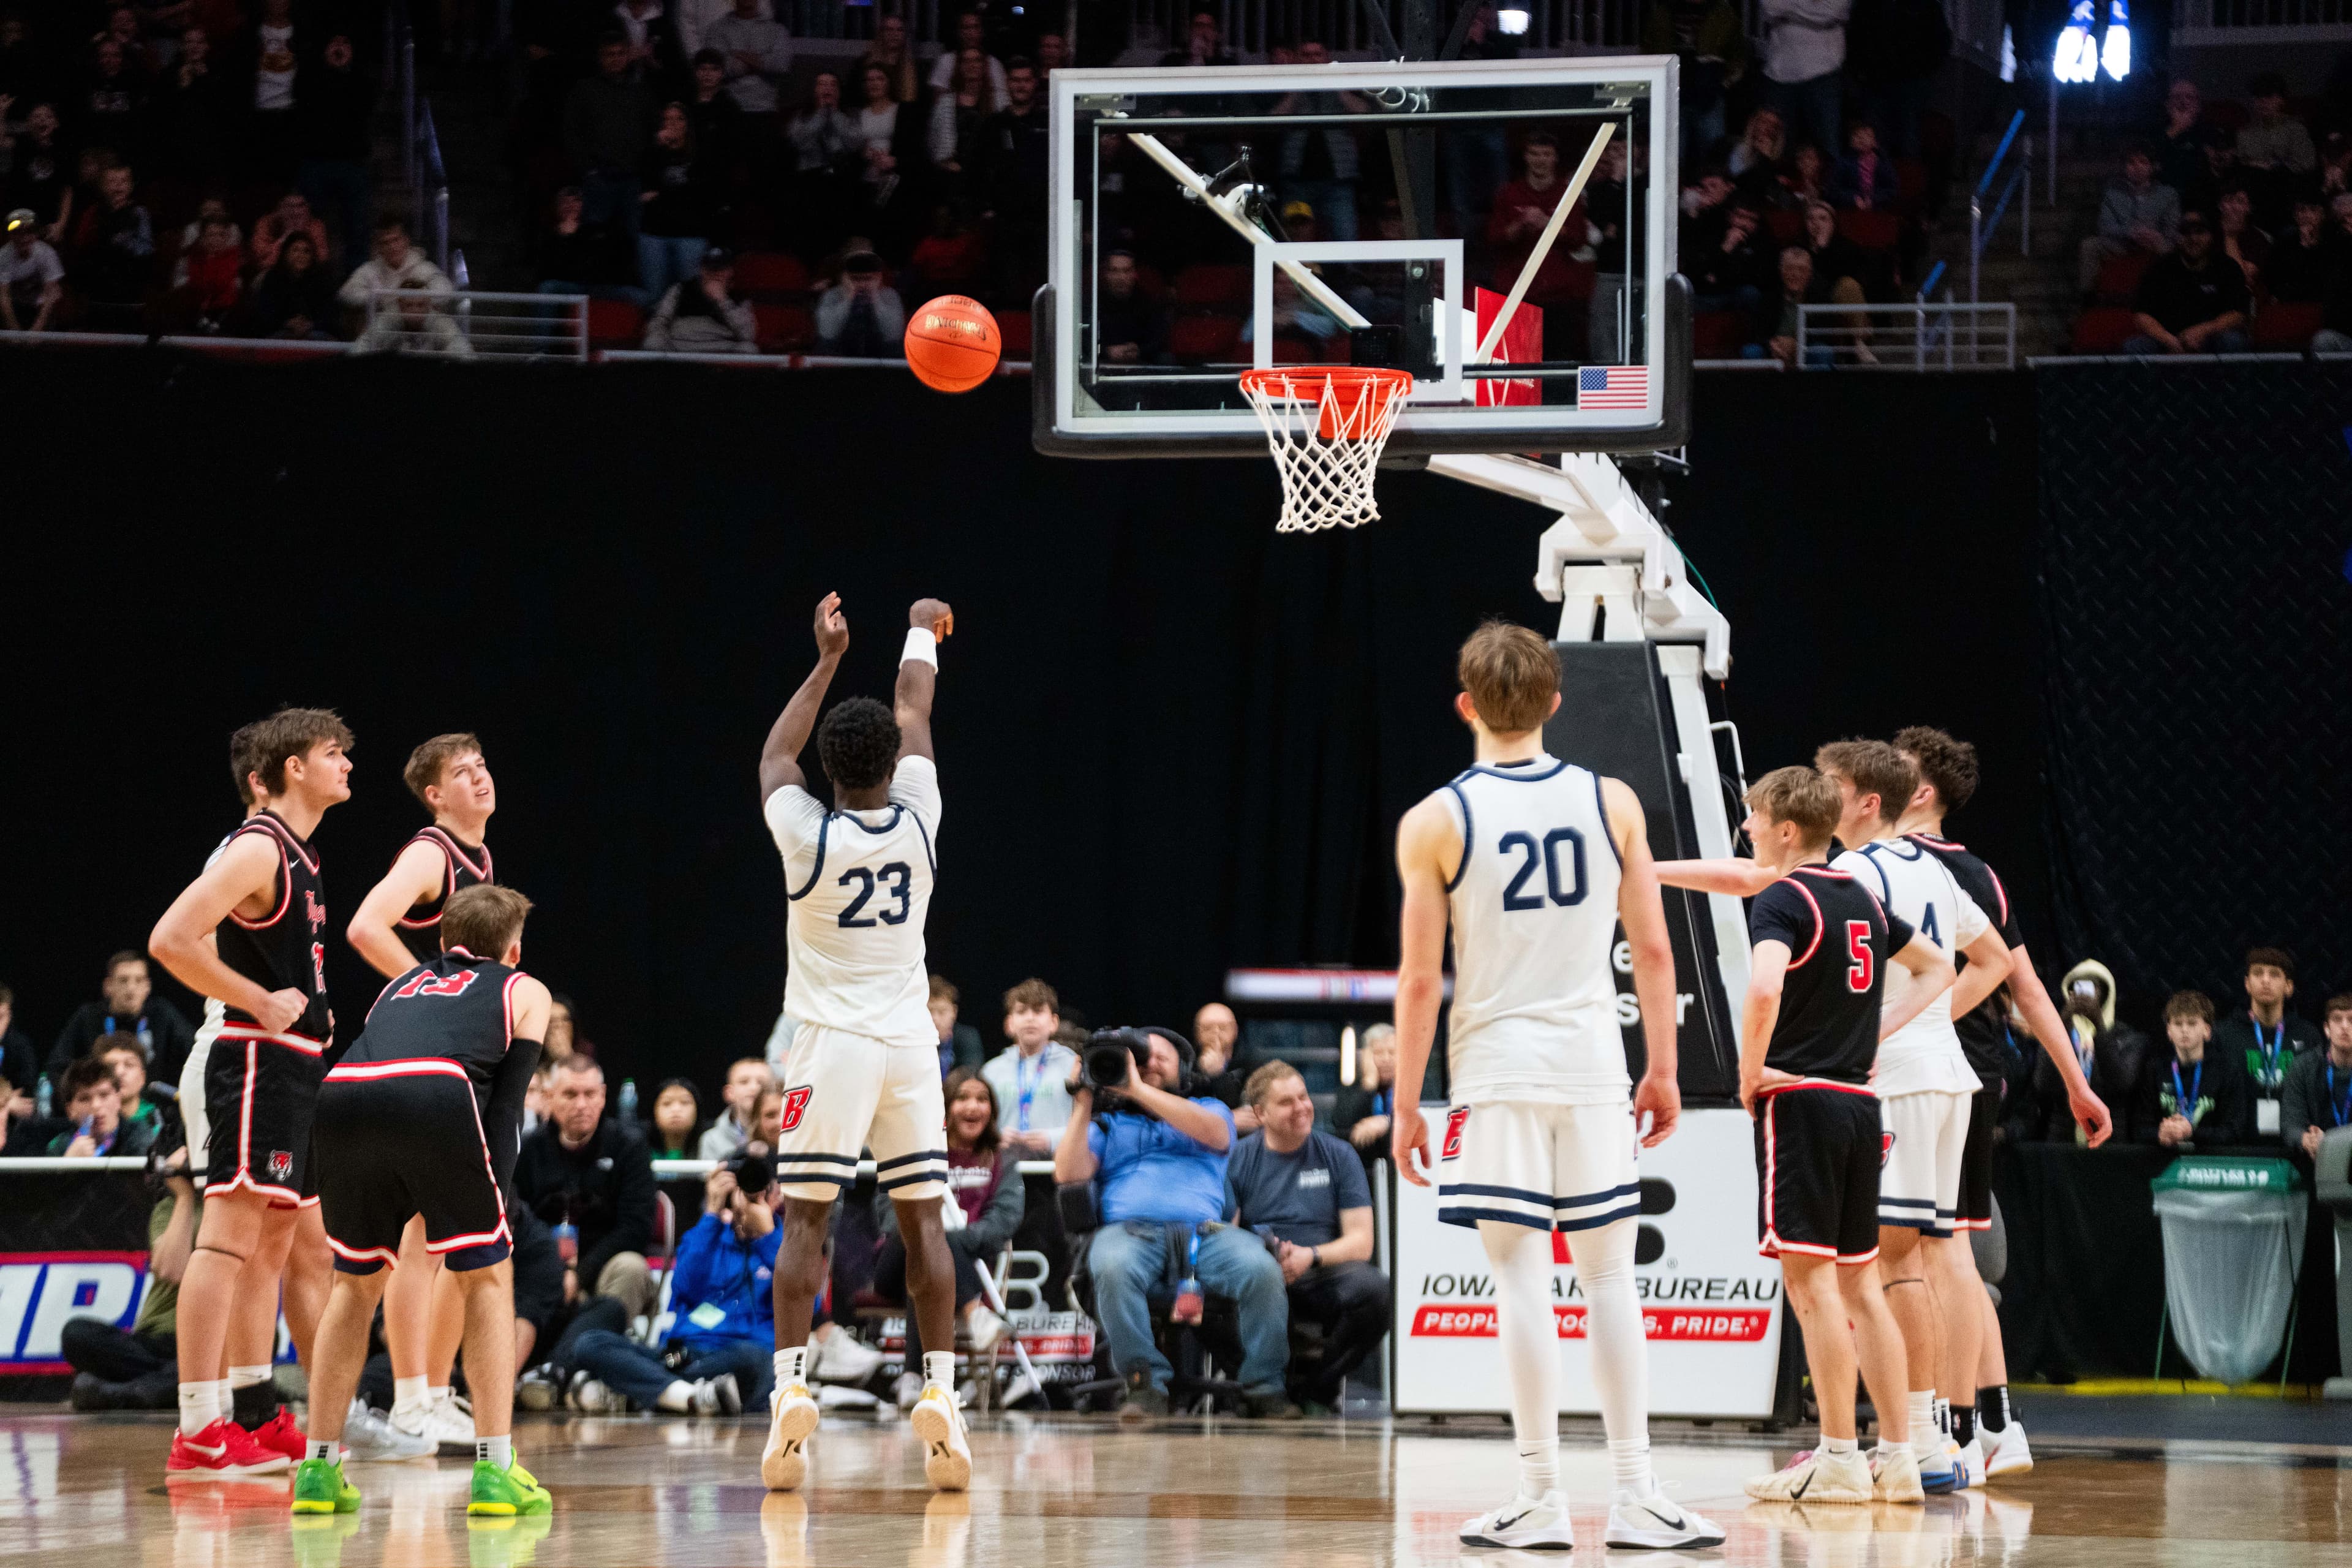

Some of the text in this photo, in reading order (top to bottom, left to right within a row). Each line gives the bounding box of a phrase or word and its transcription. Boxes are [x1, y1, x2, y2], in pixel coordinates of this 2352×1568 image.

[1499, 826, 1590, 911] 20
[838, 861, 911, 928] 23
[1845, 919, 1873, 993] 5
[390, 969, 480, 1001] 13
[780, 1084, 813, 1133] B
[1421, 1274, 1496, 1297] IOW
[1635, 1277, 1779, 1300] BUREAU
[1423, 1313, 1498, 1332] PEOPL
